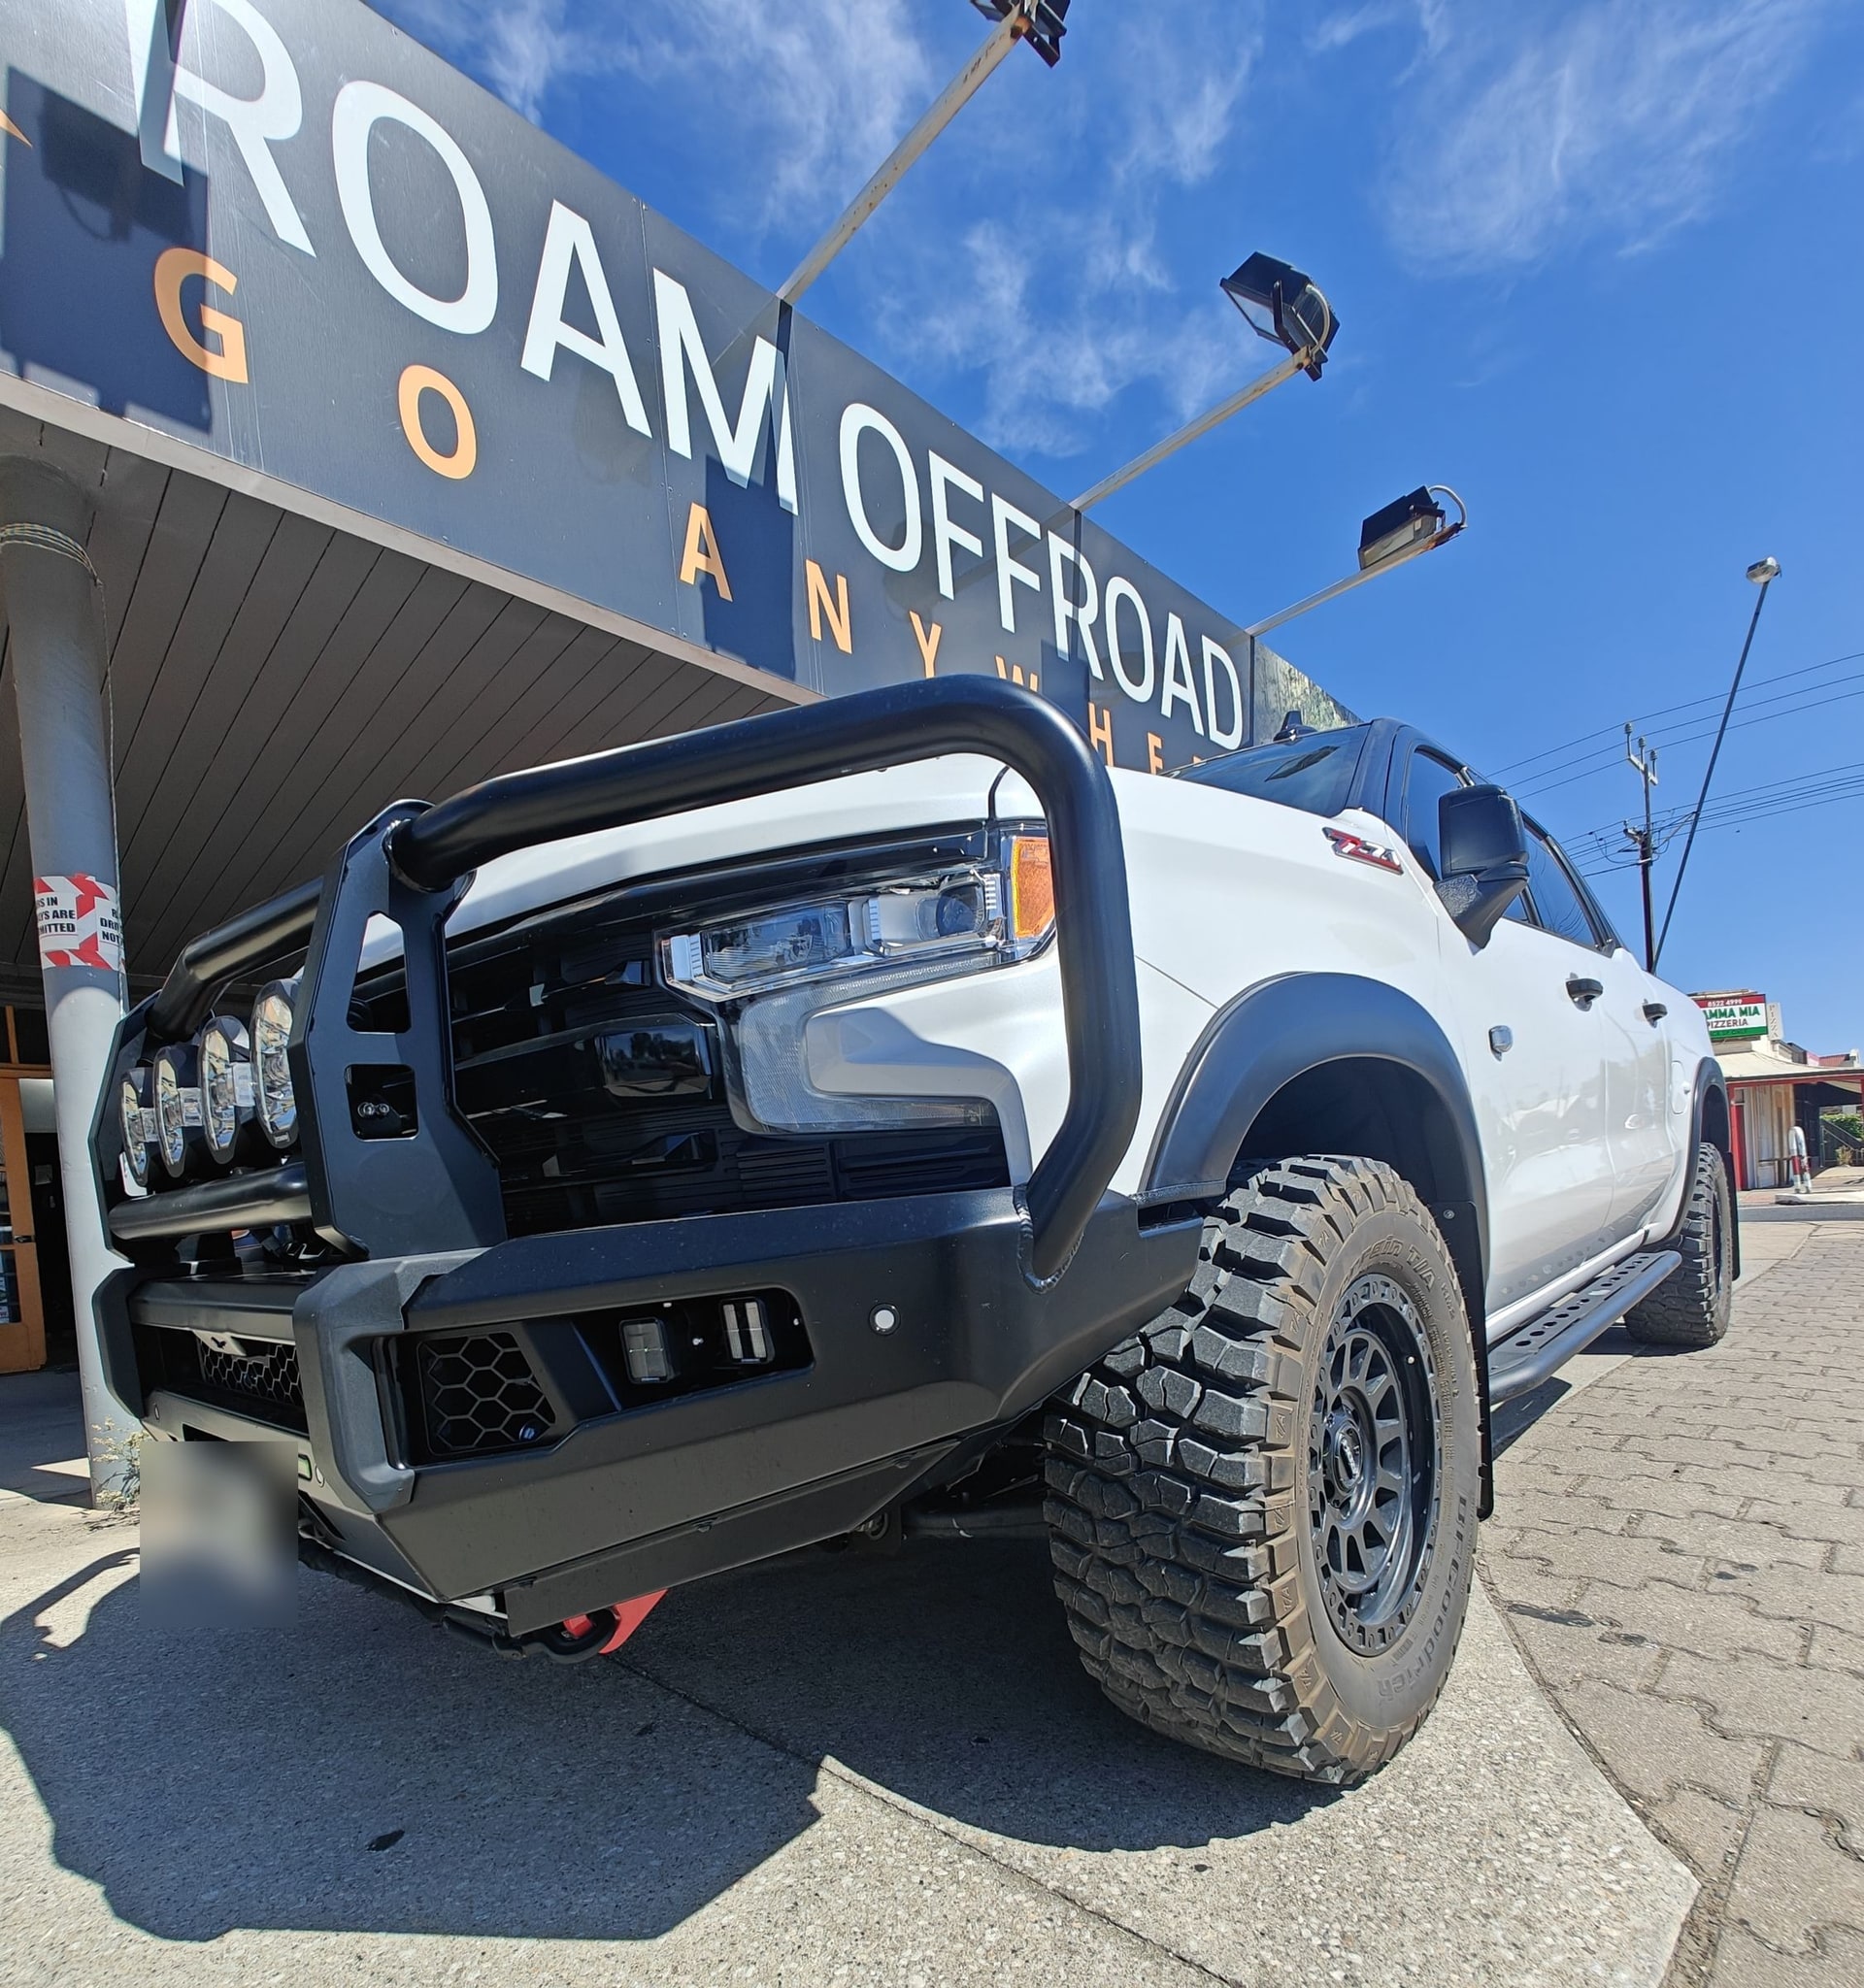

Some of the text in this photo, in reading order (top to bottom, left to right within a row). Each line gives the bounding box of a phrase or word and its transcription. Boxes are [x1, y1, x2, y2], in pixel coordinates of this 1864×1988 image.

[126, 0, 1244, 750] ROAM OFFROAD
[47, 896, 58, 907] IN
[52, 910, 76, 919] ARE
[1739, 1006, 1760, 1016] MIA
